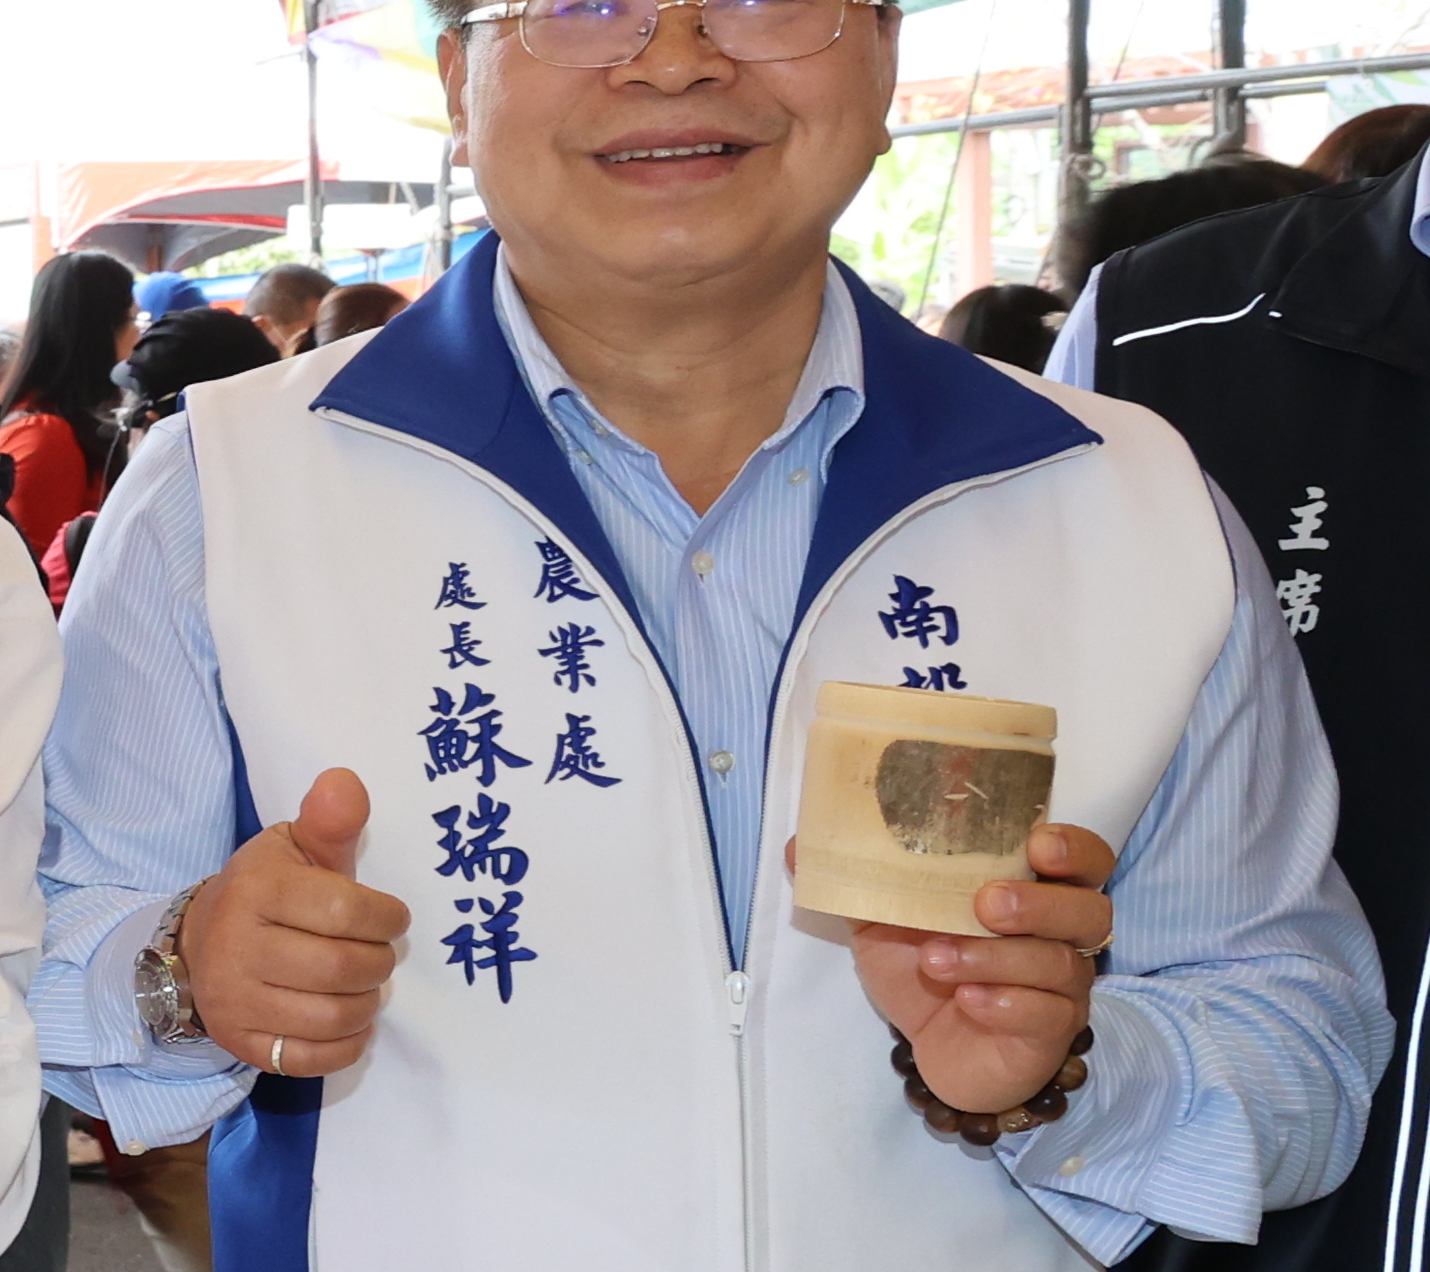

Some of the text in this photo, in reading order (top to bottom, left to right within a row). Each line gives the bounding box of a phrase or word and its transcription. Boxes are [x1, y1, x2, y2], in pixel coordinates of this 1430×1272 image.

[533, 535, 623, 788] 農業處
[1276, 486, 1330, 638] 主席
